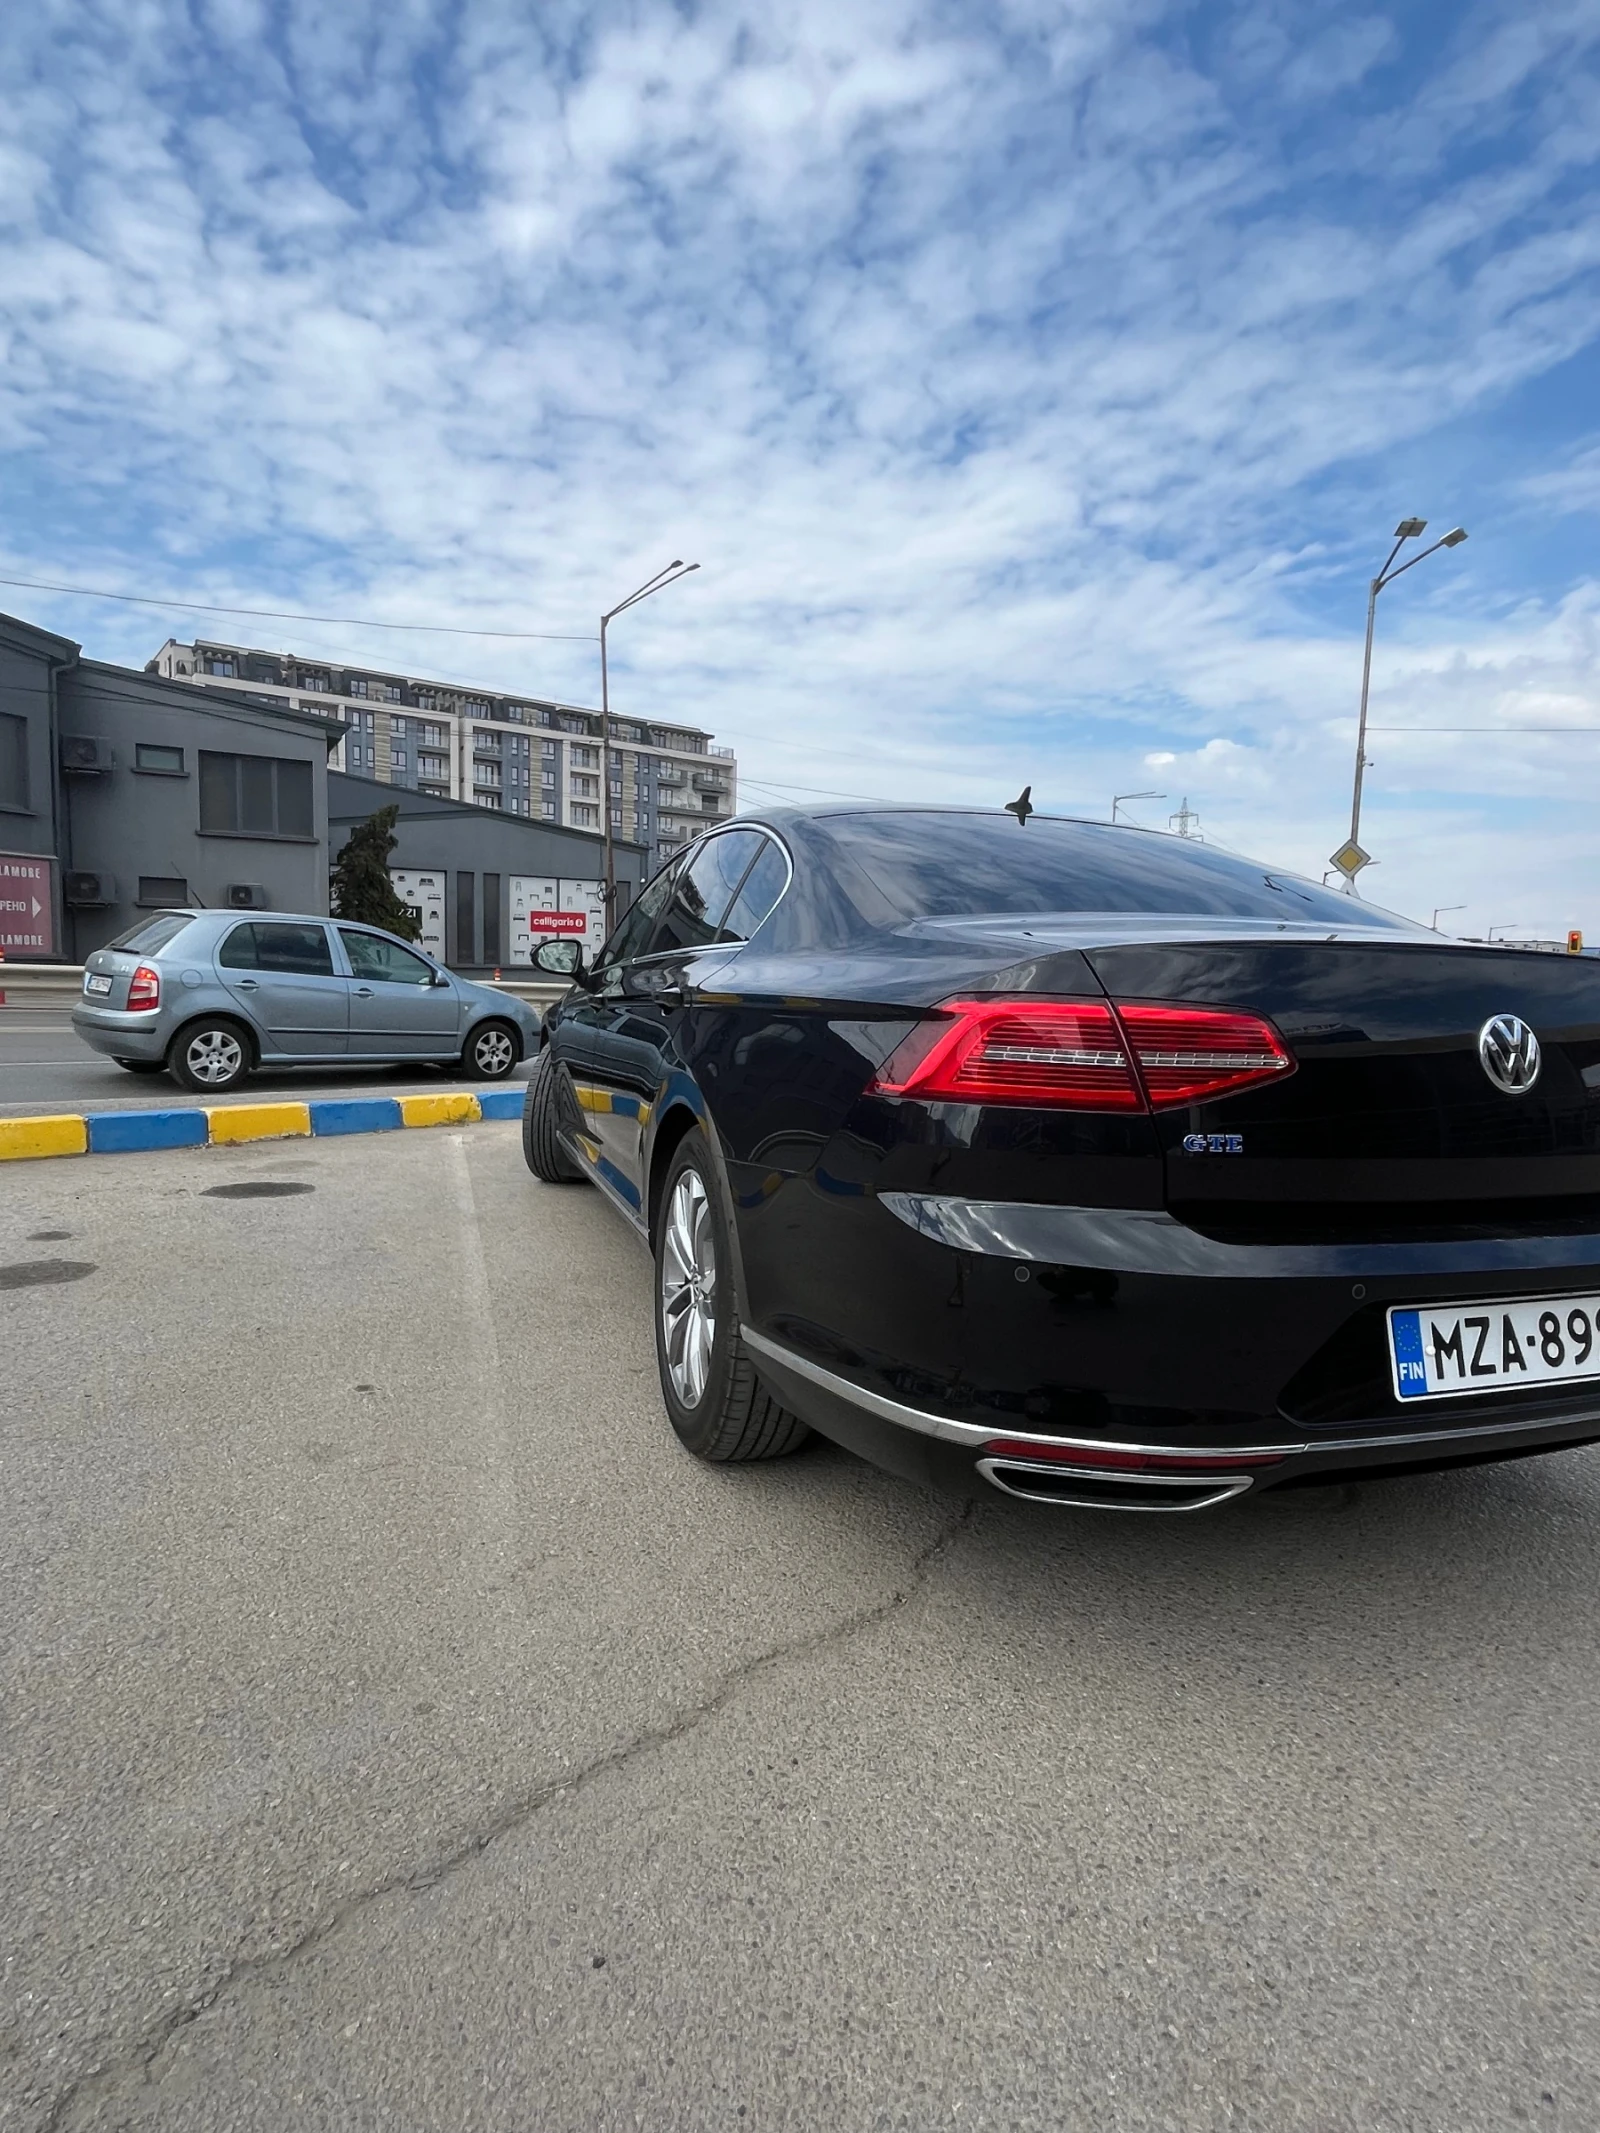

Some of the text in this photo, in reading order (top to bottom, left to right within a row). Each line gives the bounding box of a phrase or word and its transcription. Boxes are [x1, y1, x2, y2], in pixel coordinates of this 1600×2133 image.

[533, 916, 575, 928] calligaris
[1183, 1134, 1243, 1153] GTE
[1431, 1308, 1600, 1380] MZA-89
[1400, 1361, 1425, 1381] FIN
